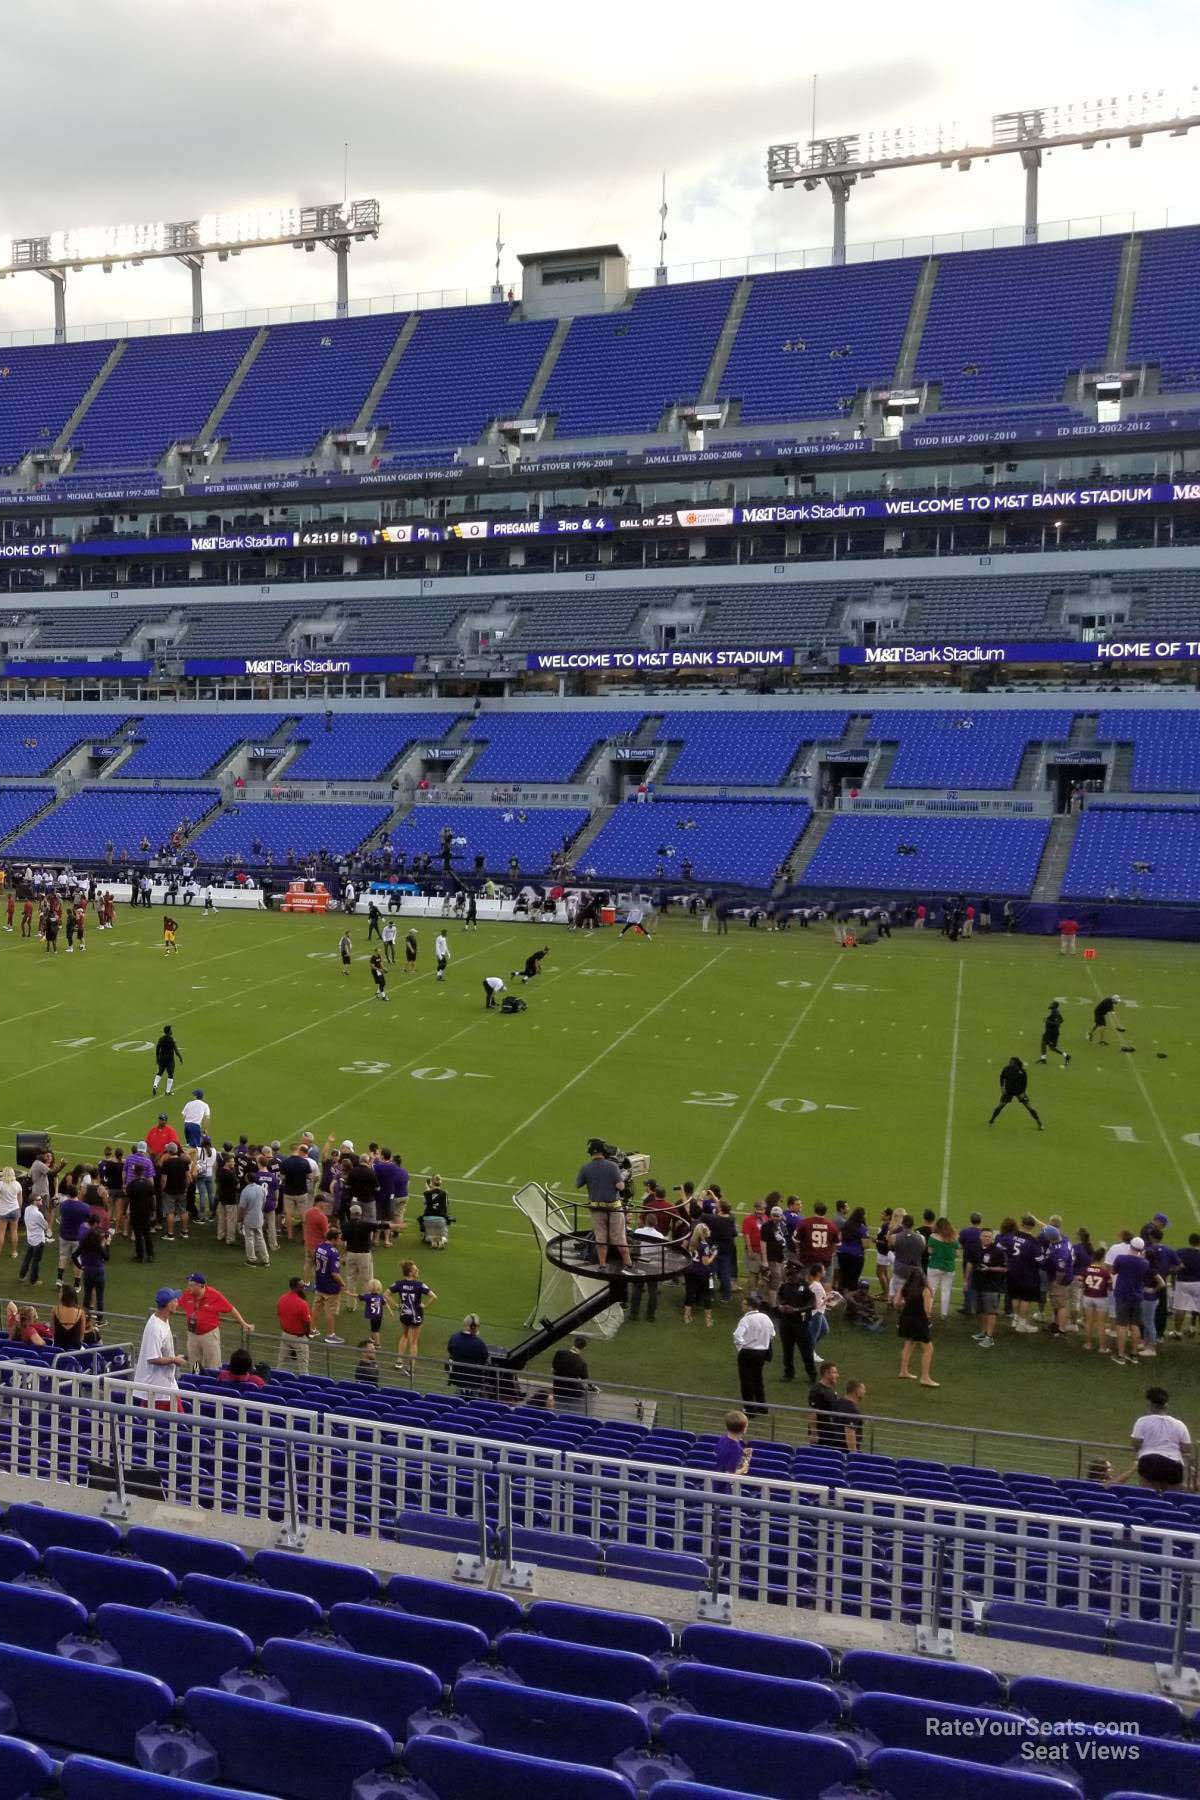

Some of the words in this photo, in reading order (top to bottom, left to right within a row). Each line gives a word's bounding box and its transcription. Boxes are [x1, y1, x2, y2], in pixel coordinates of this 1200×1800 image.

[1058, 428, 1070, 436] ED
[1073, 426, 1096, 434] REED
[1099, 422, 1150, 432] 2002-2012
[914, 437, 938, 446] TODD
[941, 435, 965, 444] HEAP
[968, 432, 1016, 442] 2001-2010
[778, 447, 793, 455] RAY
[795, 446, 819, 454] LEWIS
[821, 442, 864, 452] 1996-2012
[644, 456, 669, 465] JAMAL
[699, 452, 742, 461] 2000-2006
[520, 464, 539, 472] MATT
[541, 462, 570, 471] STOVER
[360, 474, 396, 484] JONATHAN
[397, 473, 423, 481] OGDEN
[205, 485, 224, 493] PETER
[885, 498, 963, 514] WELCOME
[968, 497, 990, 510] TO
[994, 495, 1027, 508] M&T
[1032, 493, 1075, 507] BANK
[1080, 488, 1151, 503] STADIUM
[743, 508, 775, 522] M&T
[777, 506, 809, 520] Bank
[811, 504, 865, 519] Stadium
[494, 522, 539, 534] PREGAME
[596, 518, 606, 529] 4
[620, 519, 639, 528] BALL
[643, 518, 654, 527] ON
[657, 515, 672, 526] 25
[191, 538, 218, 550] M&T
[219, 537, 243, 549] Bank
[245, 536, 286, 549] Stadium
[303, 532, 338, 544] 42:19
[31, 545, 47, 555] OF
[865, 648, 903, 662] M&T
[905, 648, 940, 661] Bank
[943, 646, 1004, 661] Stadium
[1098, 643, 1150, 657] HOME
[1155, 643, 1180, 656] OF
[245, 661, 274, 673] M&T
[275, 661, 301, 673] Bank
[304, 660, 349, 672] Stadium
[538, 655, 610, 668] WELCOME
[614, 654, 633, 666] TO
[638, 653, 669, 666] M&T
[673, 653, 712, 665] BANK
[716, 651, 783, 664] STADIUM
[52, 1036, 155, 1052] 40
[338, 1060, 458, 1081] 30
[682, 1091, 819, 1113] 20
[812, 1231, 828, 1248] 91
[1012, 1243, 1021, 1256] 5
[1085, 1276, 1103, 1289] 47
